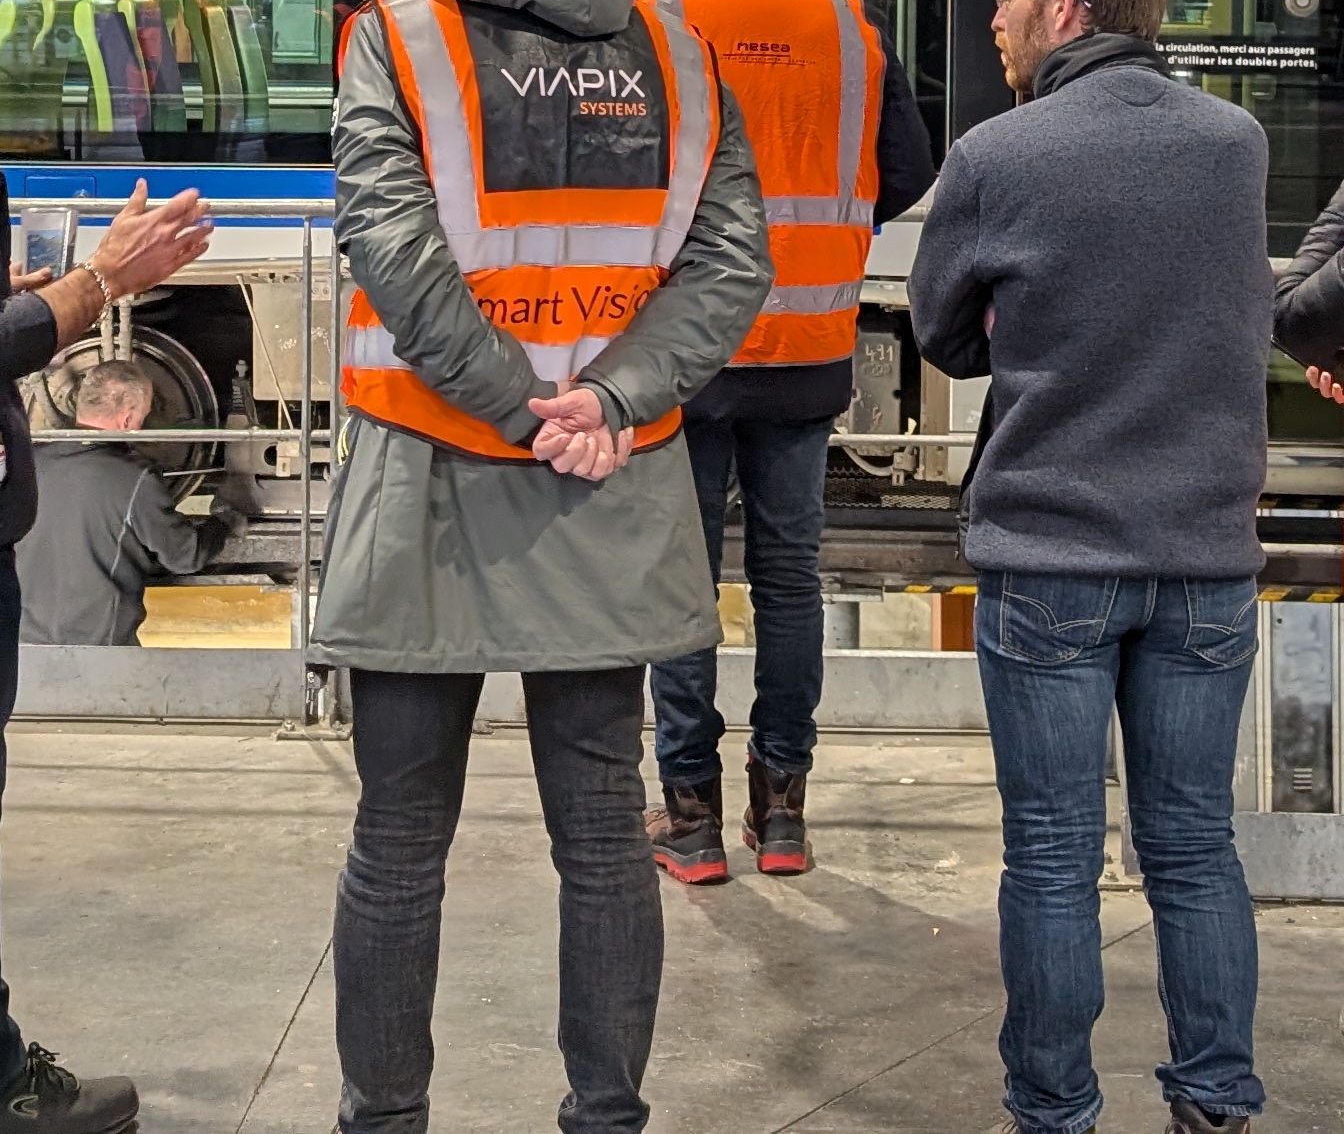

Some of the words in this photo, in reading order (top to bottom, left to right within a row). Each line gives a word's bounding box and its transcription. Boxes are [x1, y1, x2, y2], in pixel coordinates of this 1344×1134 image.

[1165, 42, 1219, 54] circulation,
[1219, 43, 1247, 54] merci
[1247, 46, 1266, 54] aux
[1267, 46, 1315, 57] passagers
[1167, 55, 1216, 66] d'utiliser
[1217, 55, 1233, 66] les
[1235, 56, 1278, 67] doubles
[500, 66, 646, 98] VIAPIX
[579, 101, 647, 117] SYSTEMS
[469, 287, 564, 326] mart
[865, 343, 894, 363] 491
